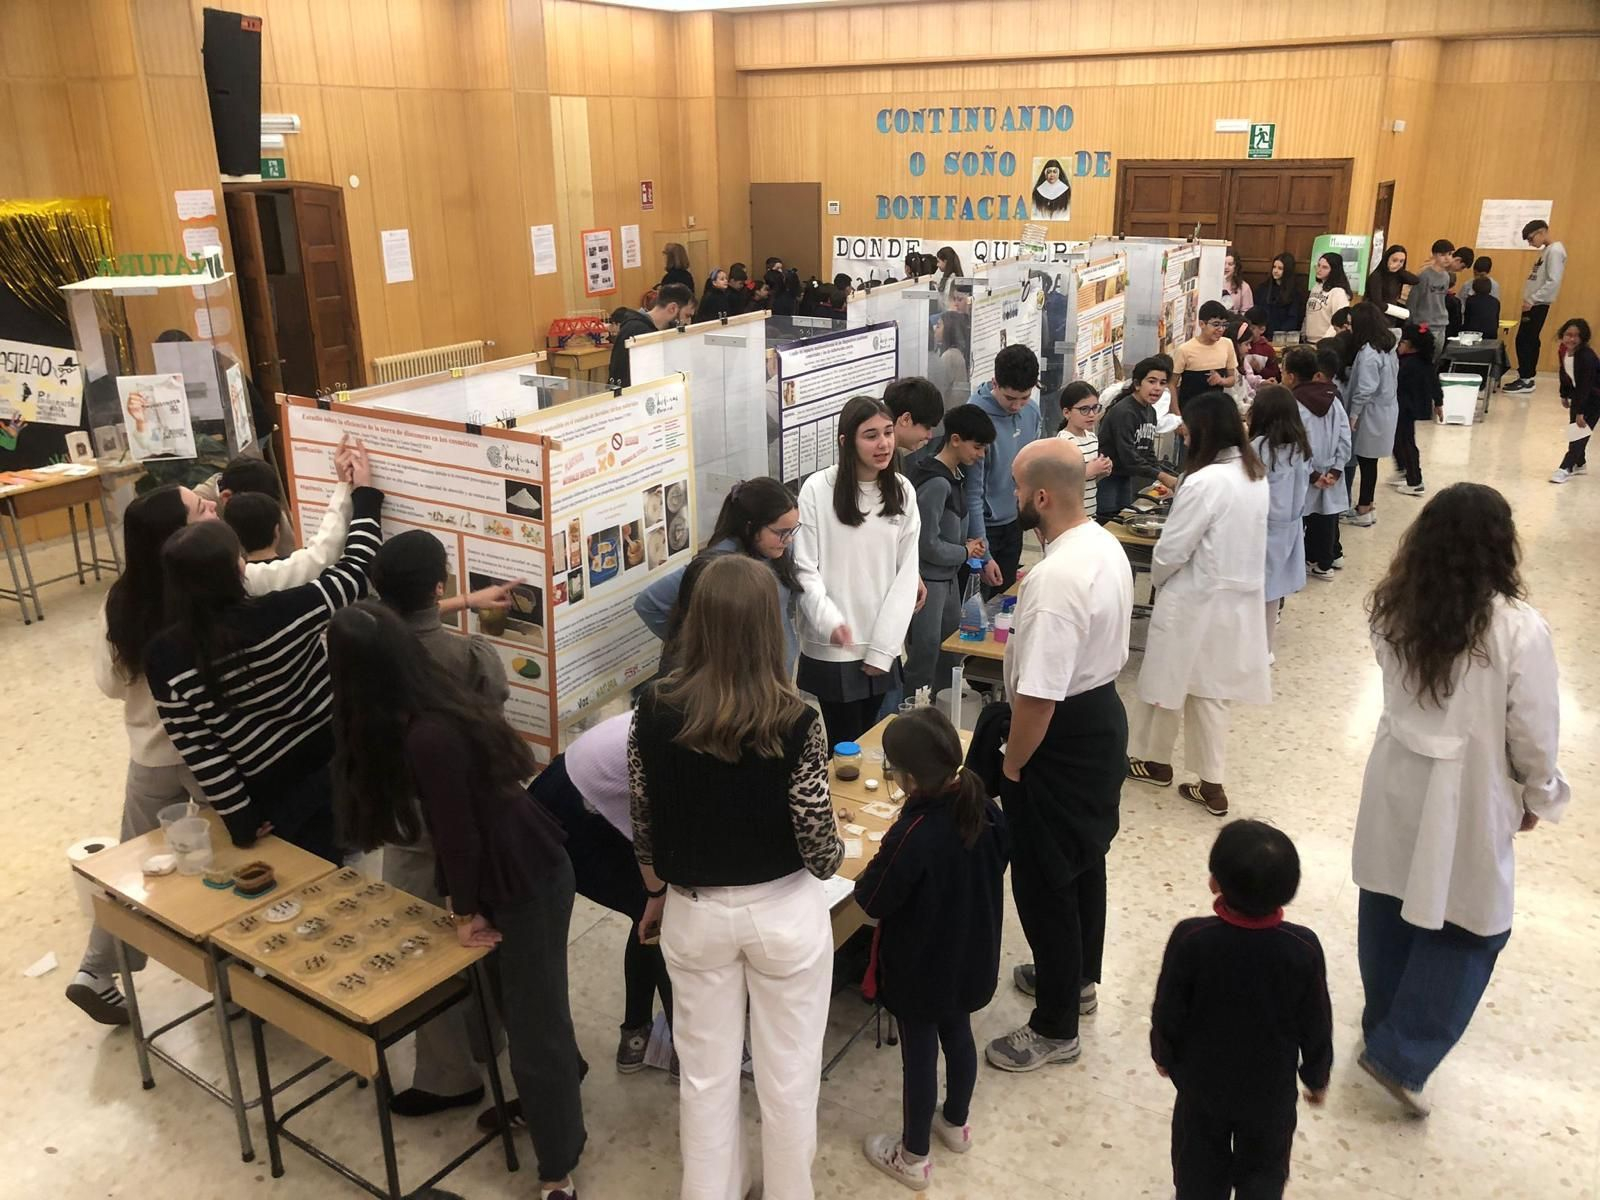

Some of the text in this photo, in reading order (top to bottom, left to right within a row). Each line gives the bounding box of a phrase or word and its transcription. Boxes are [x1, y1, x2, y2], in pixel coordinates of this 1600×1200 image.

[876, 104, 1074, 134] CONTINUANDO
[909, 145, 1112, 178] O SOÑO DE
[875, 194, 1029, 221] BONIFACIA
[836, 237, 920, 259] DONDE
